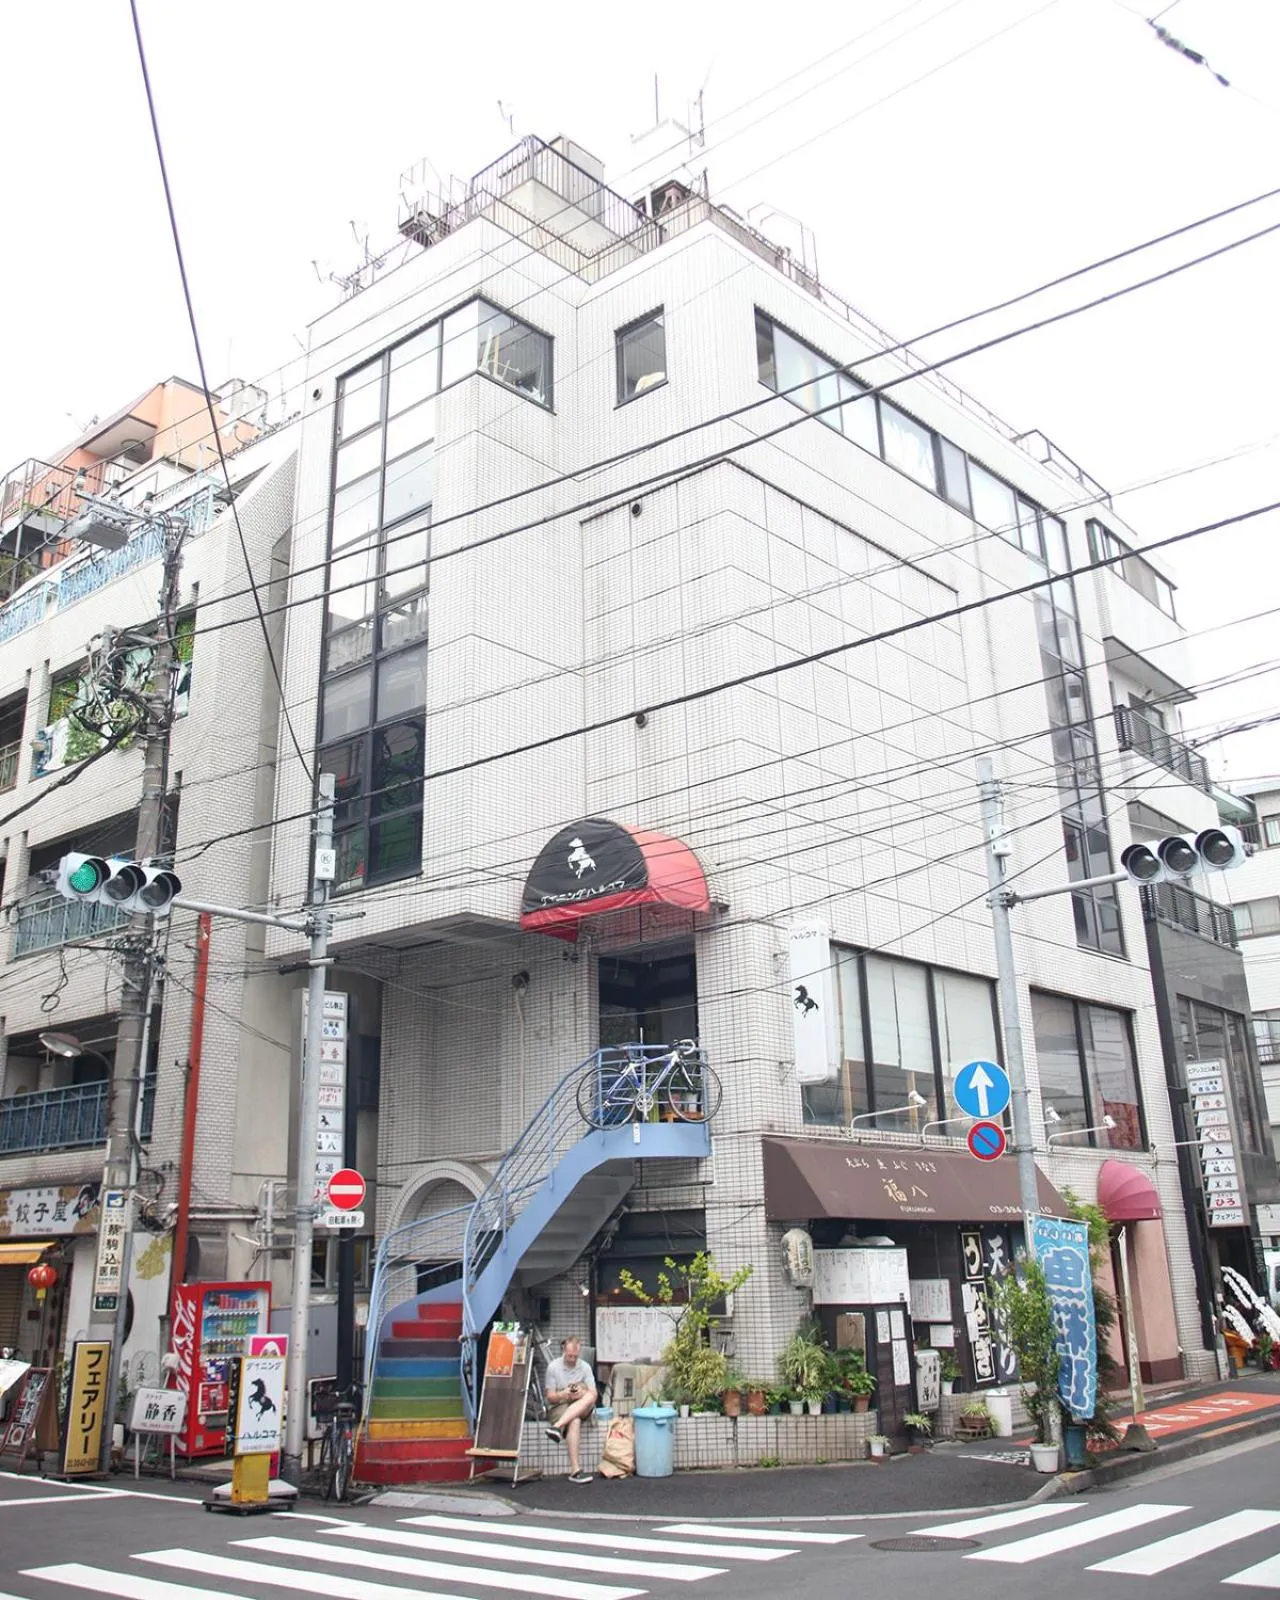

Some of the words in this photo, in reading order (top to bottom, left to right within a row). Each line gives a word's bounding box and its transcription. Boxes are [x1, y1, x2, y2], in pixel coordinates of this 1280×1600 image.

[881, 1178, 929, 1202] 福八
[1215, 1198, 1236, 1207] ひろ
[15, 1201, 68, 1224] 餃子屋
[1215, 1212, 1241, 1220] フェアリー
[246, 1361, 282, 1372] ダイニング
[81, 1349, 103, 1455] フェアリー
[145, 1402, 177, 1422] 静香
[242, 1429, 278, 1440] ハルコマ
